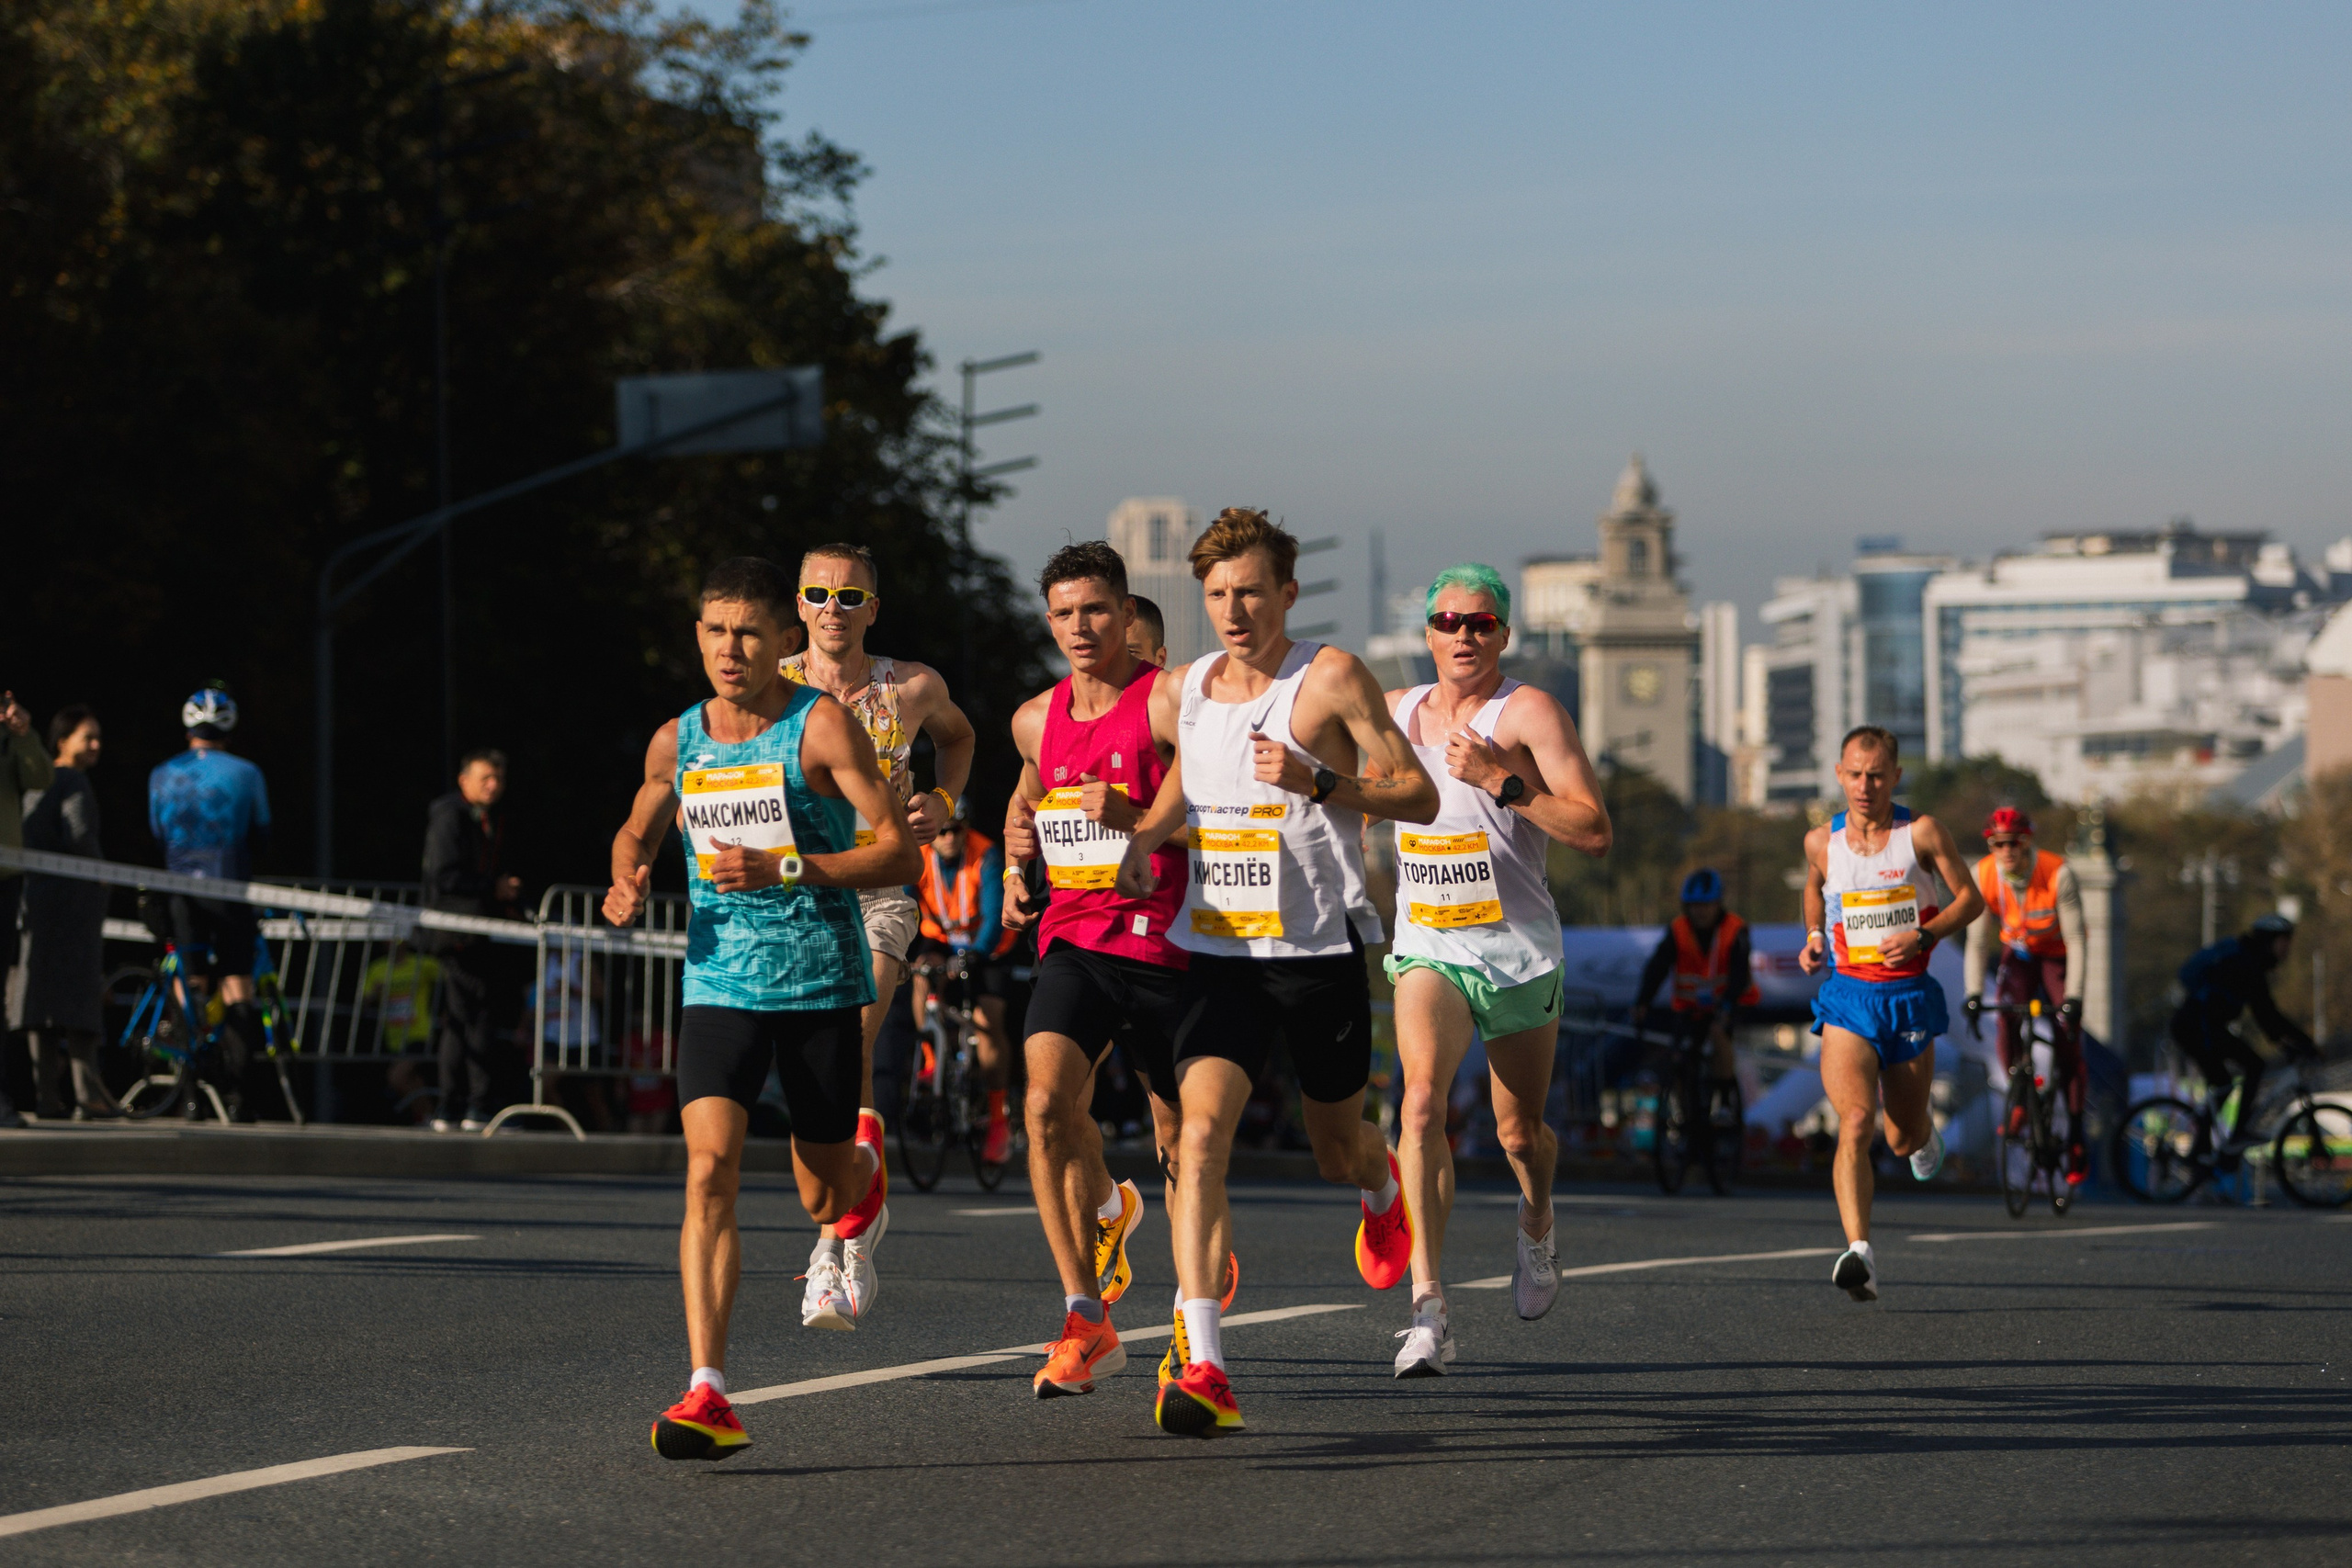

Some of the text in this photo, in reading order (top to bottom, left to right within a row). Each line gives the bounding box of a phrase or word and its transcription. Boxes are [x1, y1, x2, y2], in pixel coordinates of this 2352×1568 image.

[707, 771, 744, 781] МАРАФОН
[707, 779, 739, 789] МОСКВА
[761, 775, 773, 784] КМ
[1056, 797, 1082, 807] МОСКВ
[686, 798, 783, 829] МАКСИМОВ
[1251, 807, 1283, 817] PRO
[1205, 831, 1240, 841] МАРАФОН
[730, 837, 742, 846] 12
[1205, 839, 1234, 848] МОСКВА
[1258, 840, 1270, 848] КМ
[1418, 838, 1451, 846] МАРАФОН
[1453, 843, 1466, 852] 42,2
[1079, 852, 1084, 862] 3
[1193, 856, 1272, 886] КИСЕЛЁВ
[1404, 861, 1490, 886] ГОРЛАНОВ
[1226, 897, 1231, 907] 1
[1441, 893, 1451, 901] 11
[1846, 906, 1916, 931] ХОРОШИЛОВ
